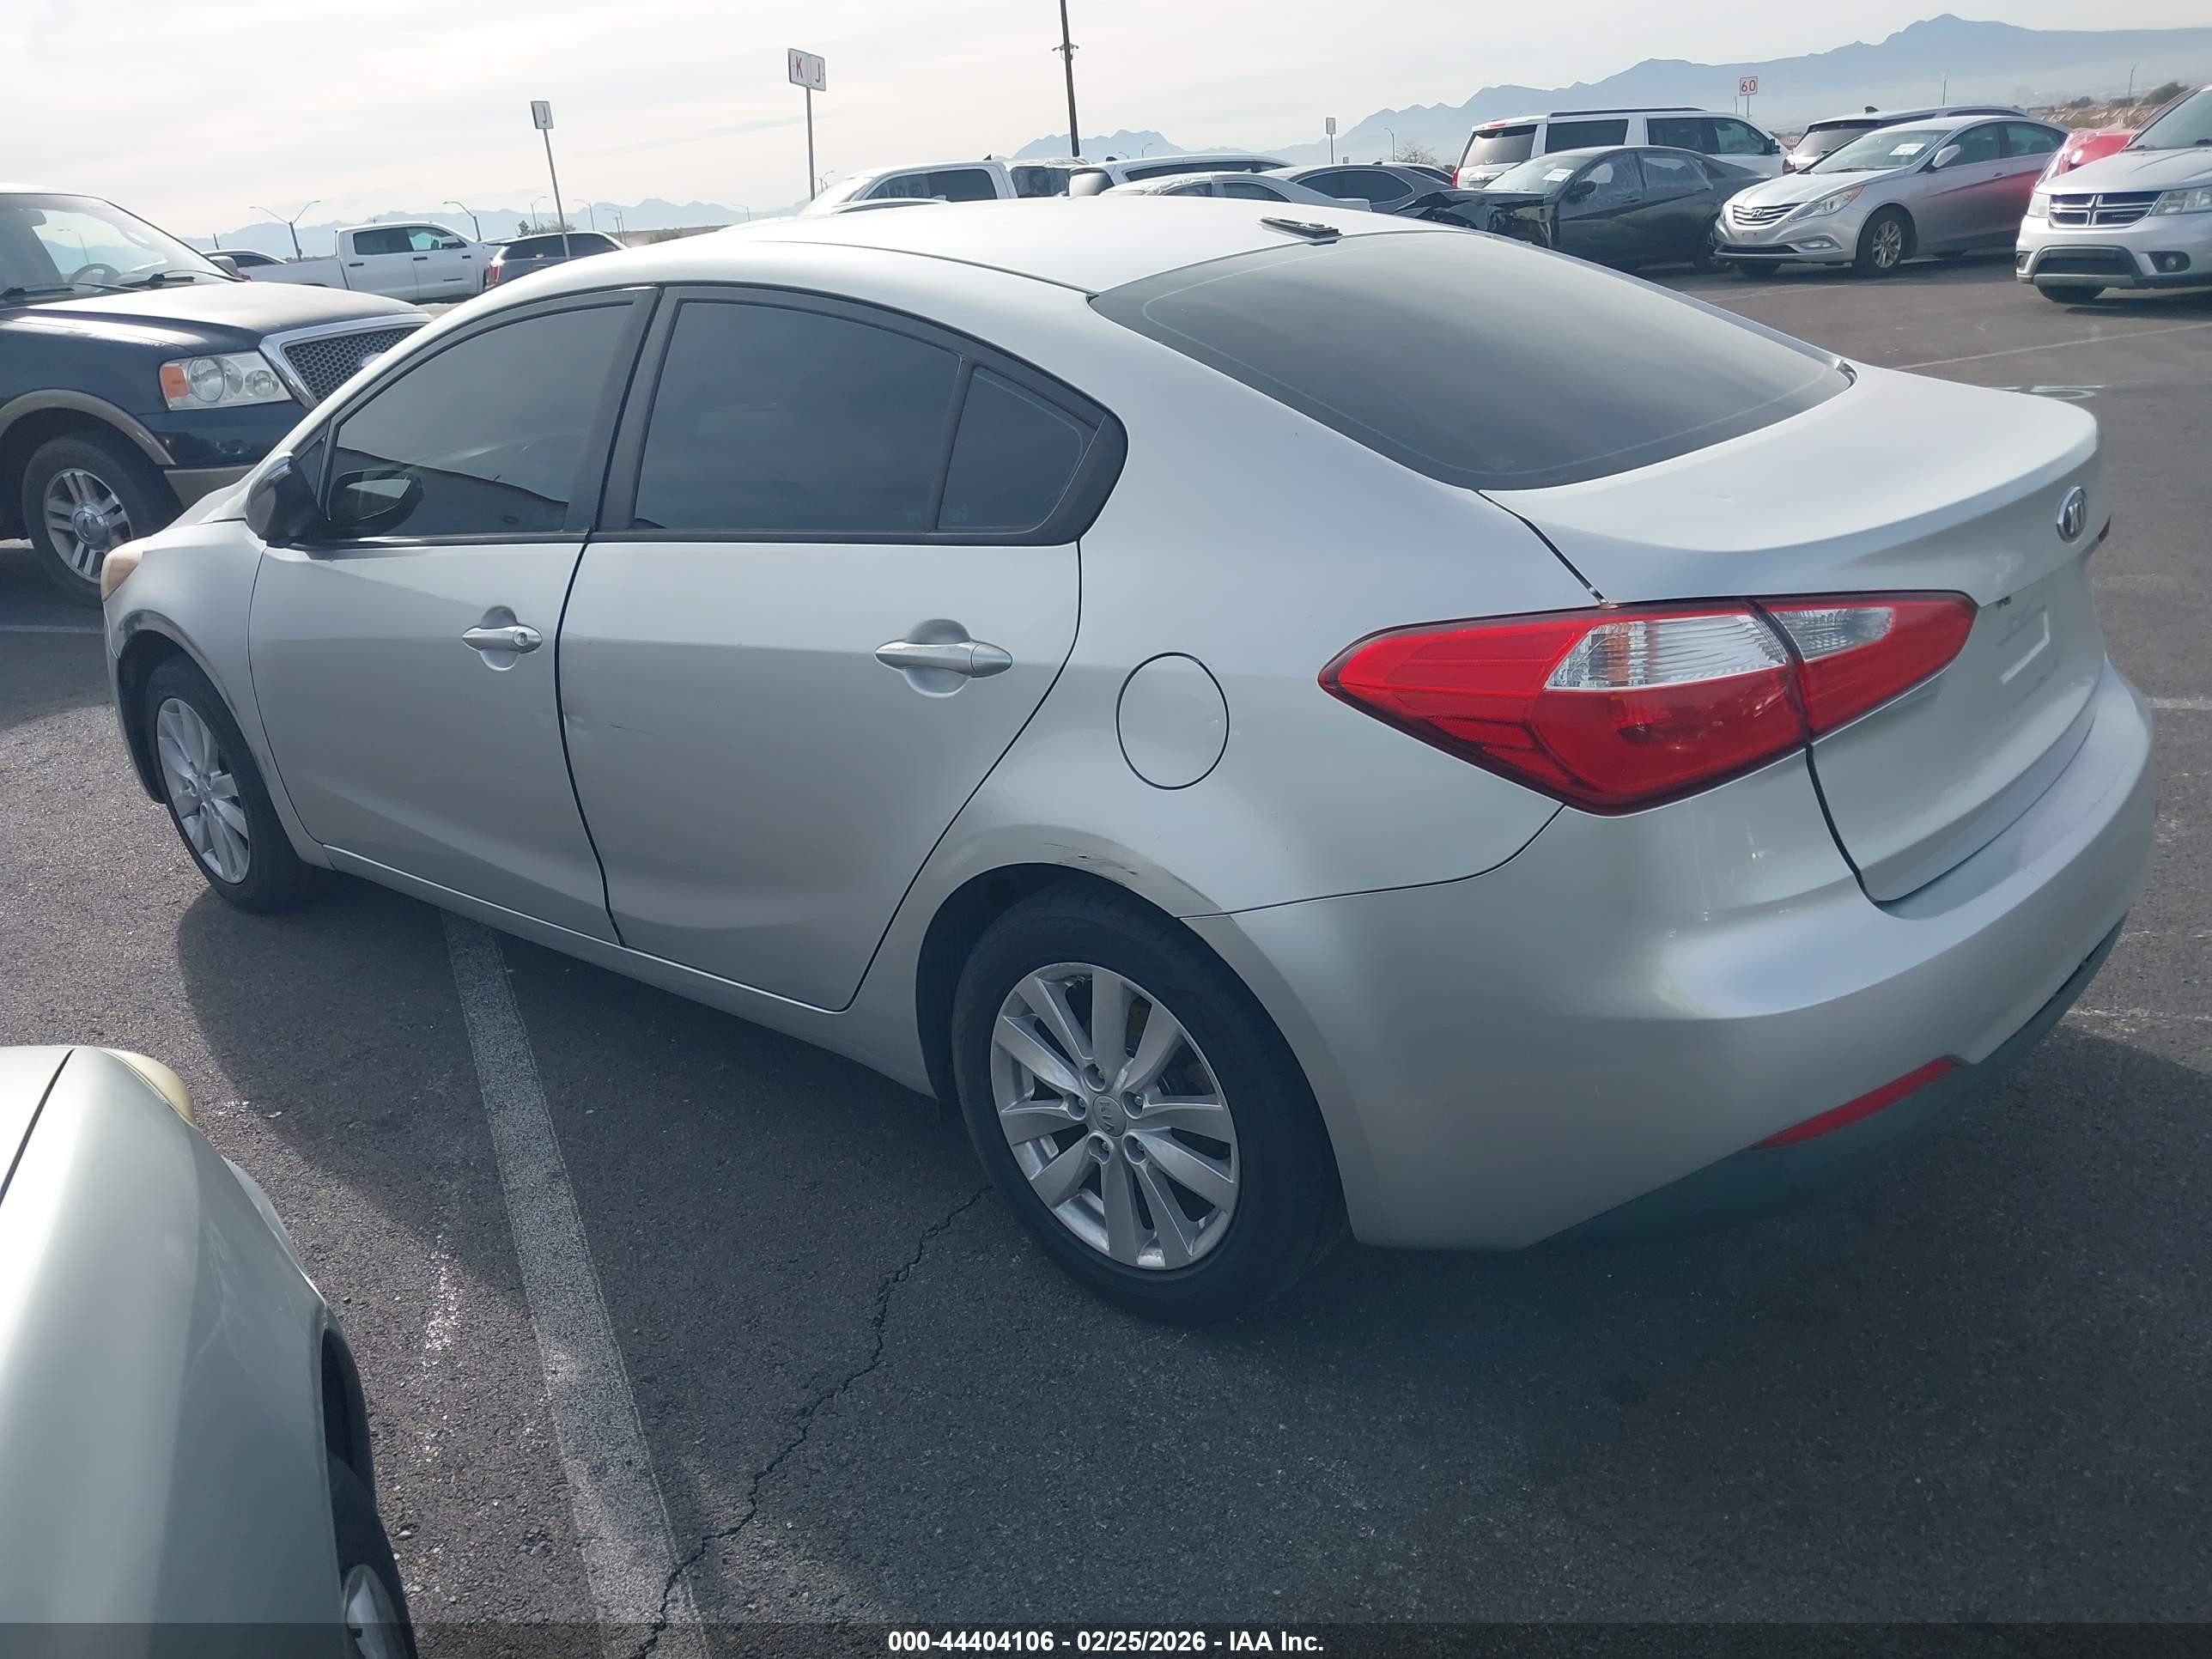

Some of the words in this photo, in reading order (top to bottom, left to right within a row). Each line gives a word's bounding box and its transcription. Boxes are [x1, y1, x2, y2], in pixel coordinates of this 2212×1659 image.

[795, 55, 804, 78] K
[815, 62, 821, 83] J
[1741, 79, 1756, 93] 60
